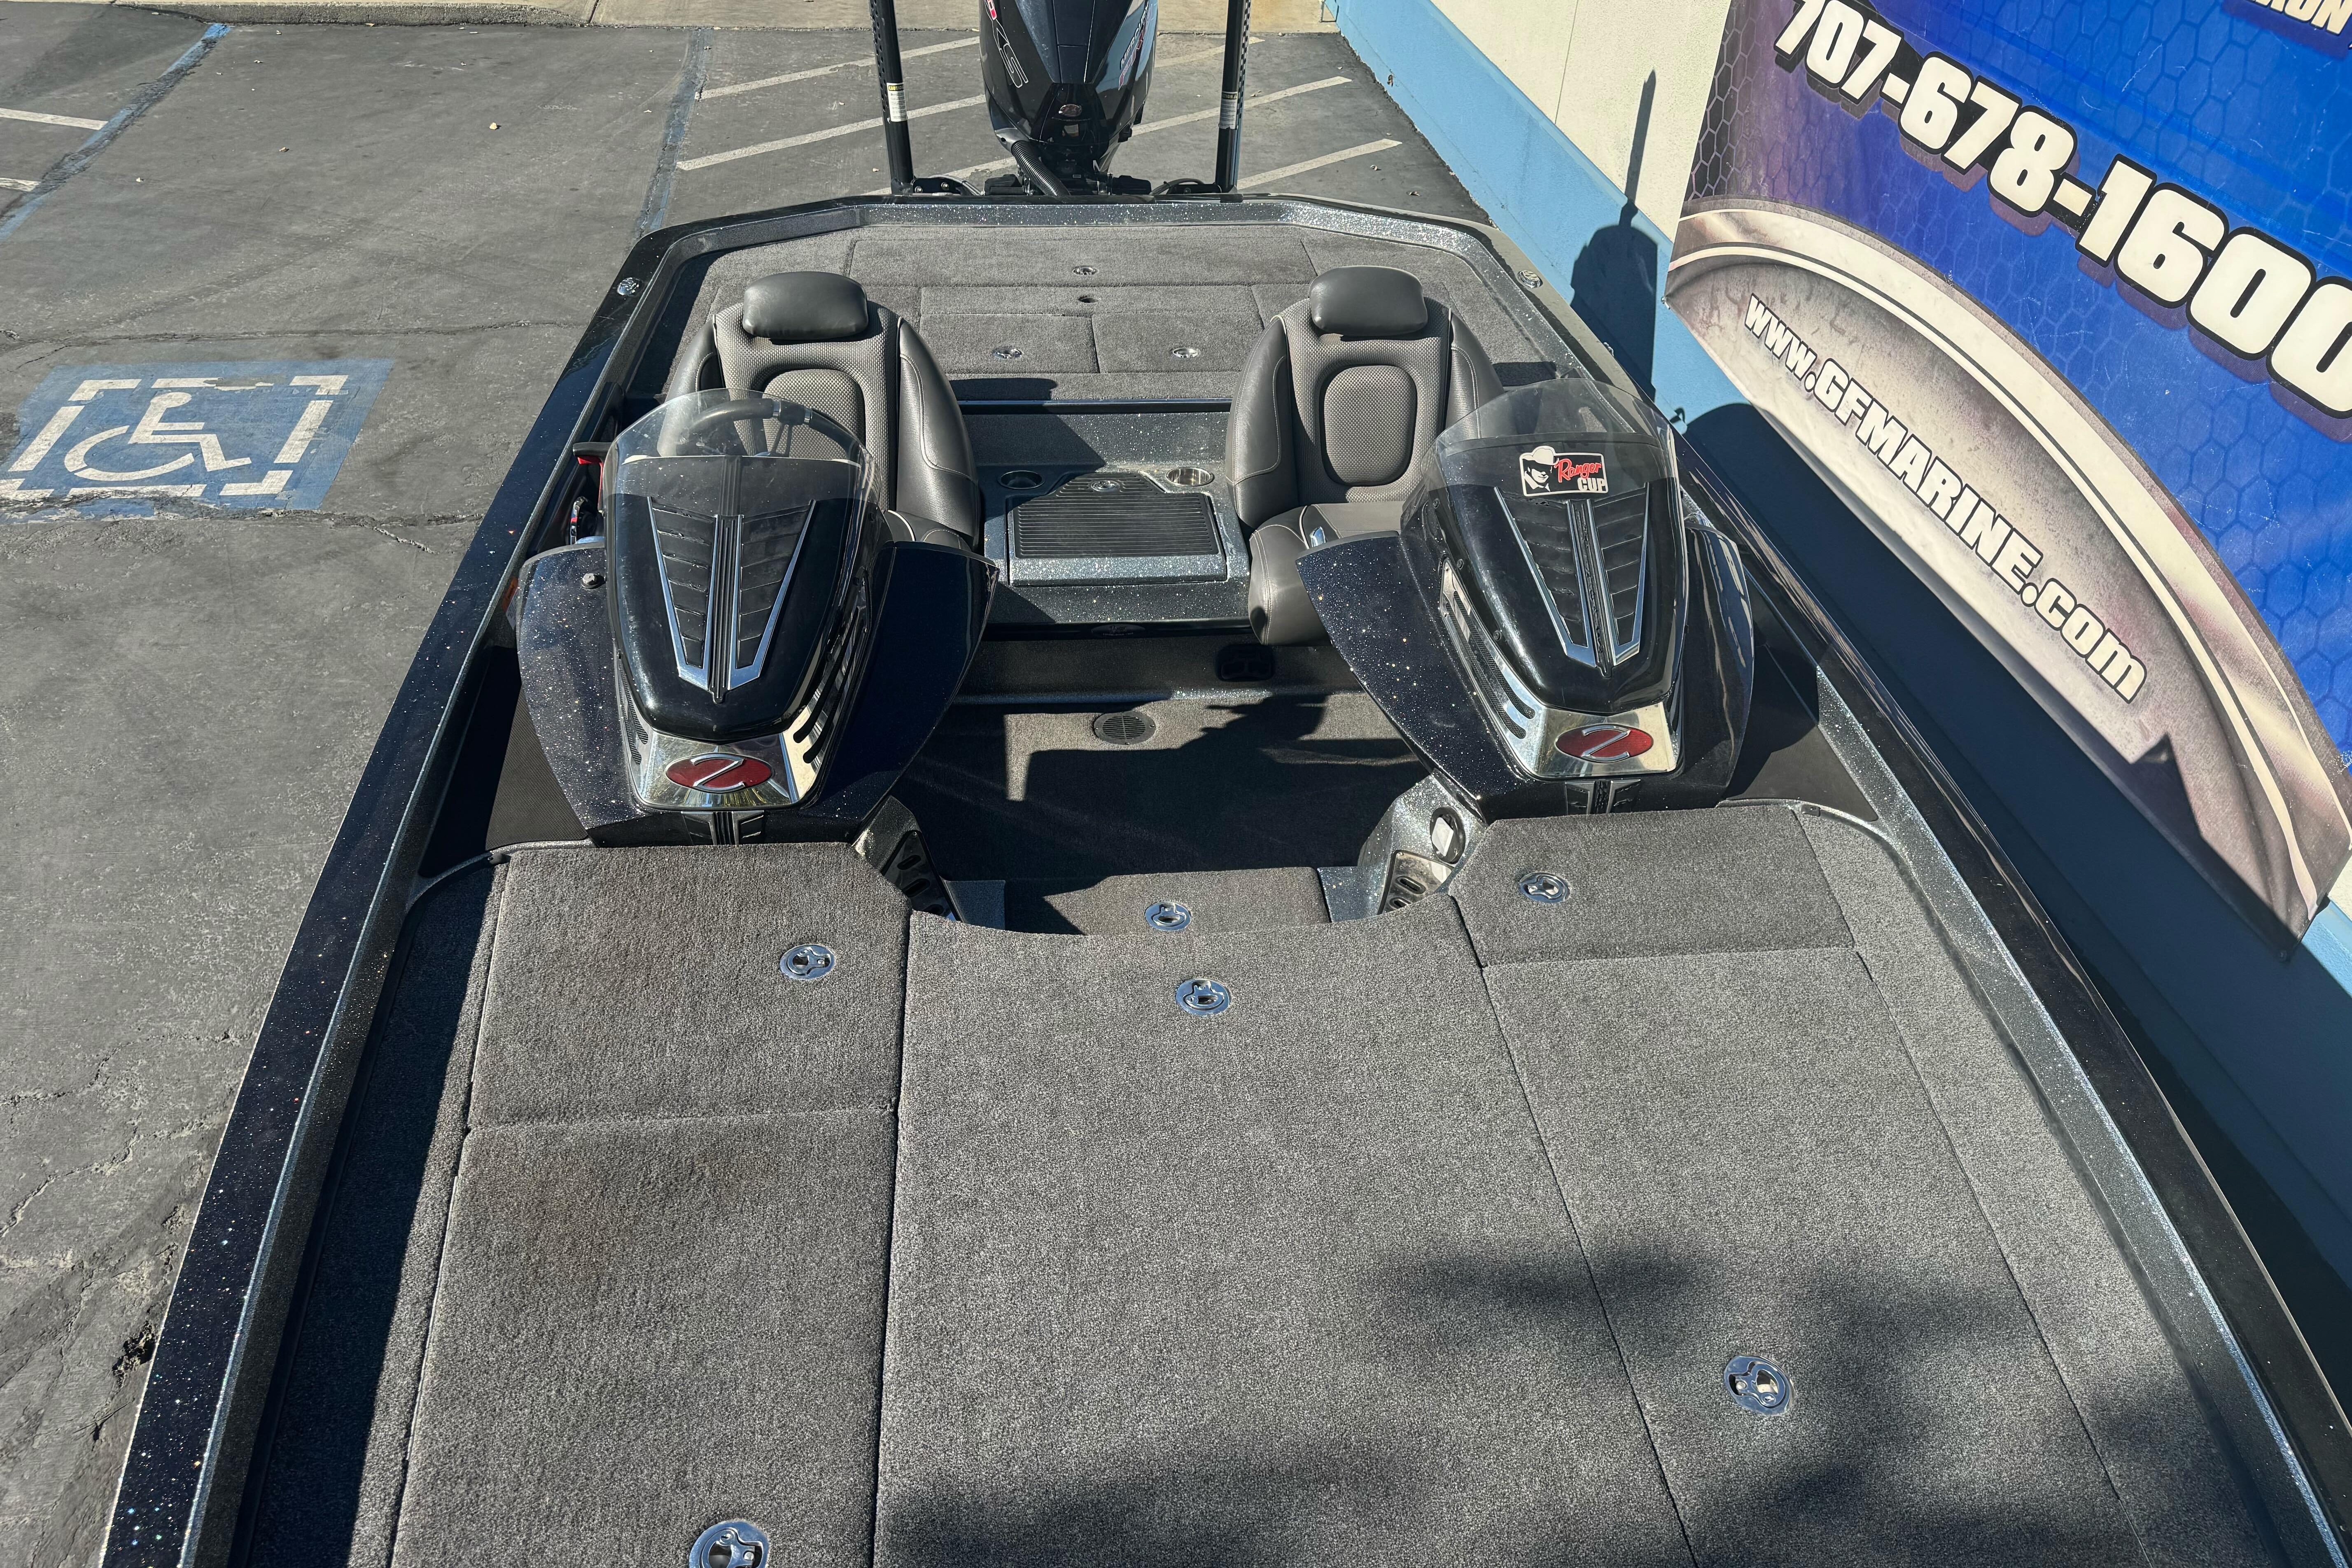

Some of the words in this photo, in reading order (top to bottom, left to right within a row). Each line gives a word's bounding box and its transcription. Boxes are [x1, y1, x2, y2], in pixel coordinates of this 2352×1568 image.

[1773, 0, 2352, 417] 707-678-1600
[1554, 458, 1602, 483] Ranger
[1577, 477, 1606, 492] CUP
